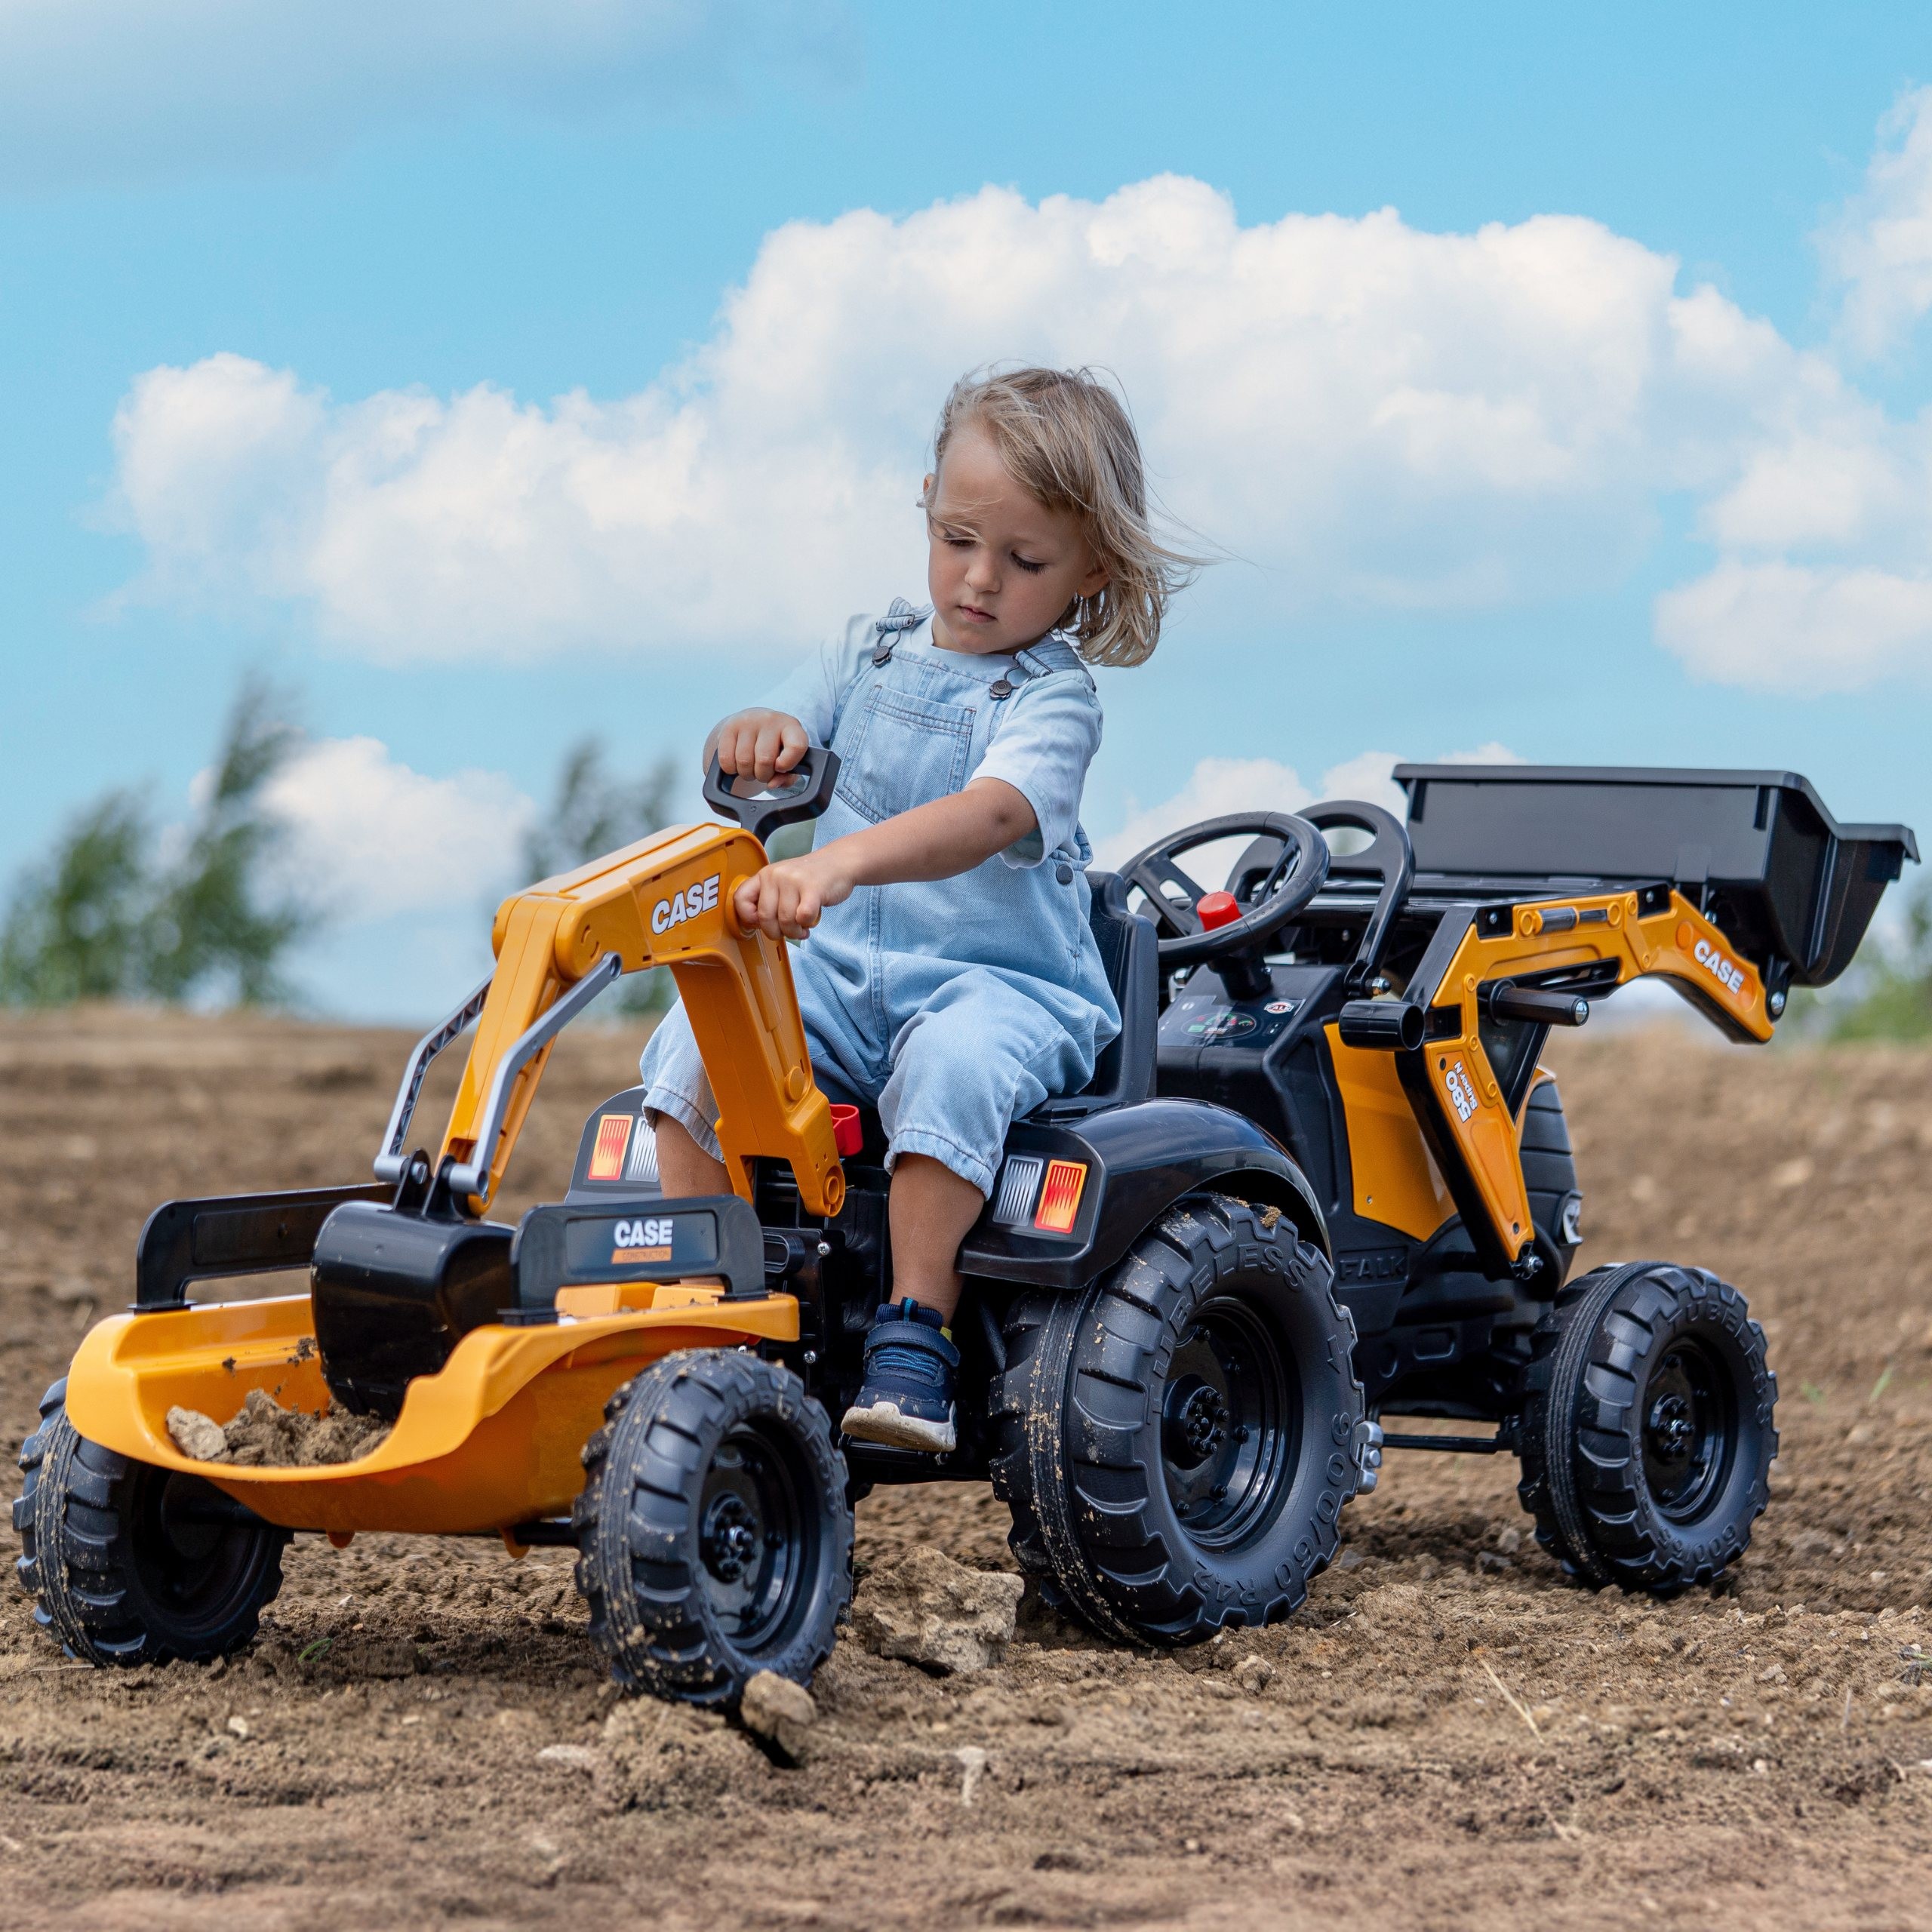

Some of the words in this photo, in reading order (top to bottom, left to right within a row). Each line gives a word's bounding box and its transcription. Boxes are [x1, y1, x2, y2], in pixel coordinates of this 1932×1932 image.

[652, 872, 721, 935] CASE
[1694, 939, 1746, 995] CASE
[1454, 1060, 1464, 1075] N
[1459, 1073, 1478, 1111] Super
[1445, 1069, 1472, 1123] 580
[614, 1218, 674, 1247] CASE
[1339, 1255, 1407, 1280] FALK
[1146, 1242, 1306, 1425] TUBELESS
[1667, 1299, 1771, 1428] TUBELESS
[1275, 1411, 1352, 1590] 900/60
[1192, 1558, 1261, 1605] R42
